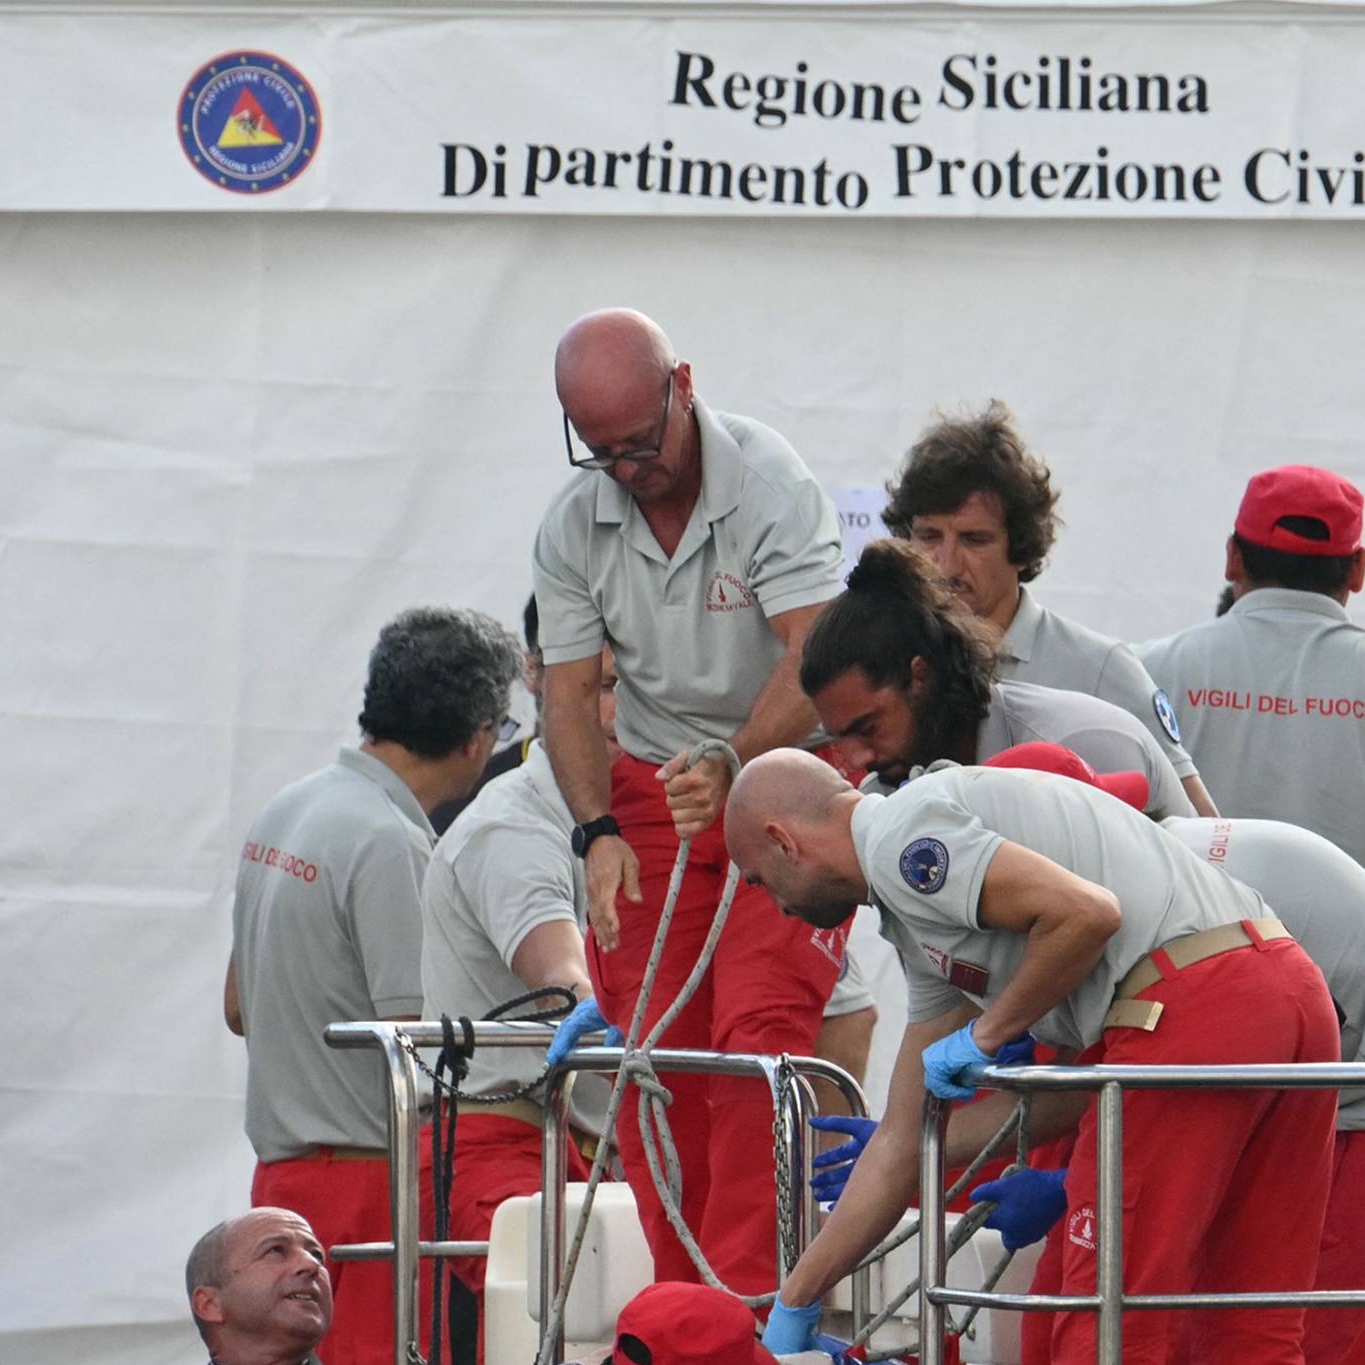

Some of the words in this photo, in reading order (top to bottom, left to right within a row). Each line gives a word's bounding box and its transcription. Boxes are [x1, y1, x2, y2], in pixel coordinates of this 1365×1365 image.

[668, 50, 922, 129] Regione
[938, 53, 1211, 112] Siciliana
[891, 143, 1221, 200] Protezione
[1187, 688, 1251, 710] VIGILI
[1257, 695, 1298, 716] DEL
